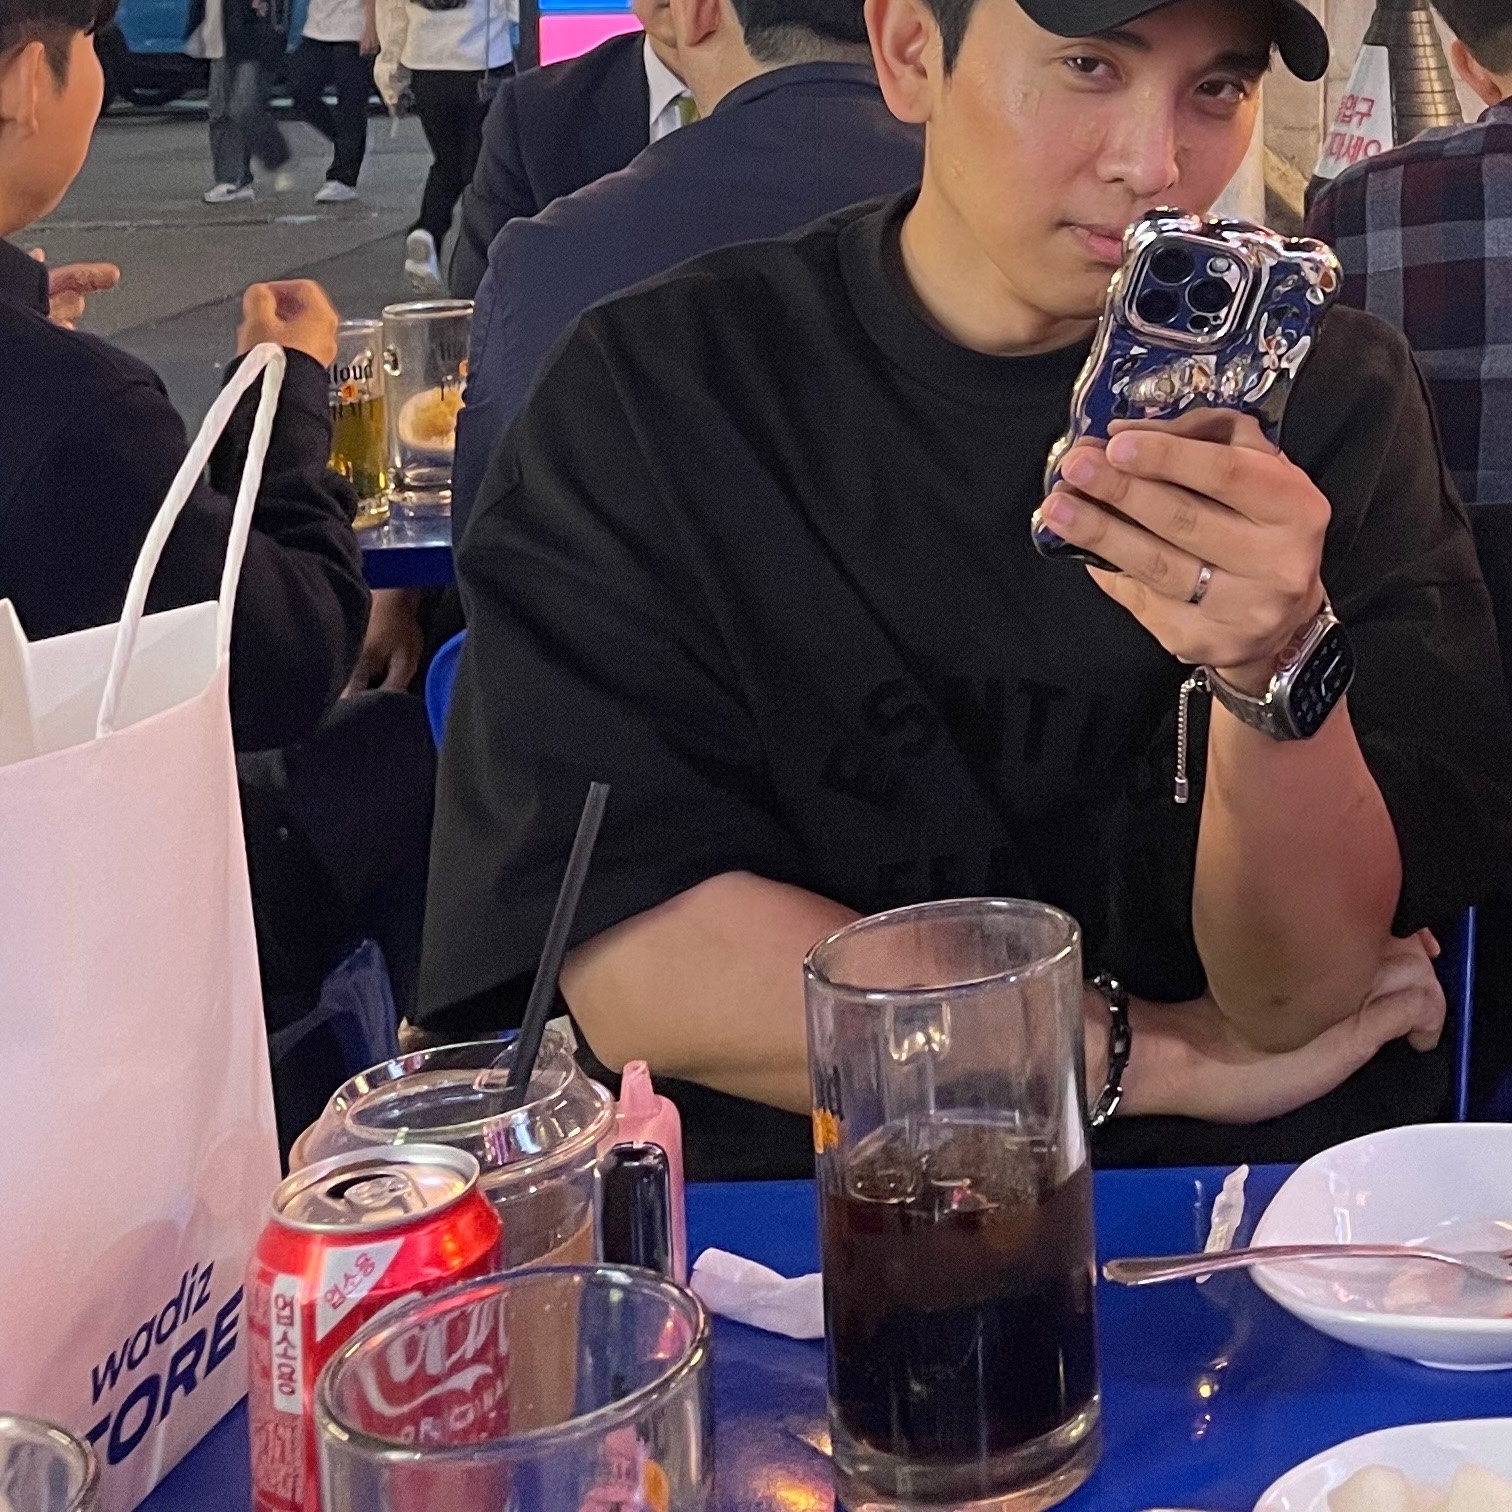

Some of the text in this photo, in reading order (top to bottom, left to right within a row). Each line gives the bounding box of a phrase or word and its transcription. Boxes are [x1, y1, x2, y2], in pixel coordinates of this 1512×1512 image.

[328, 360, 374, 385] loud
[323, 1252, 376, 1310] 업소용
[91, 1259, 216, 1406] wadiz
[274, 1293, 298, 1396] 업소용
